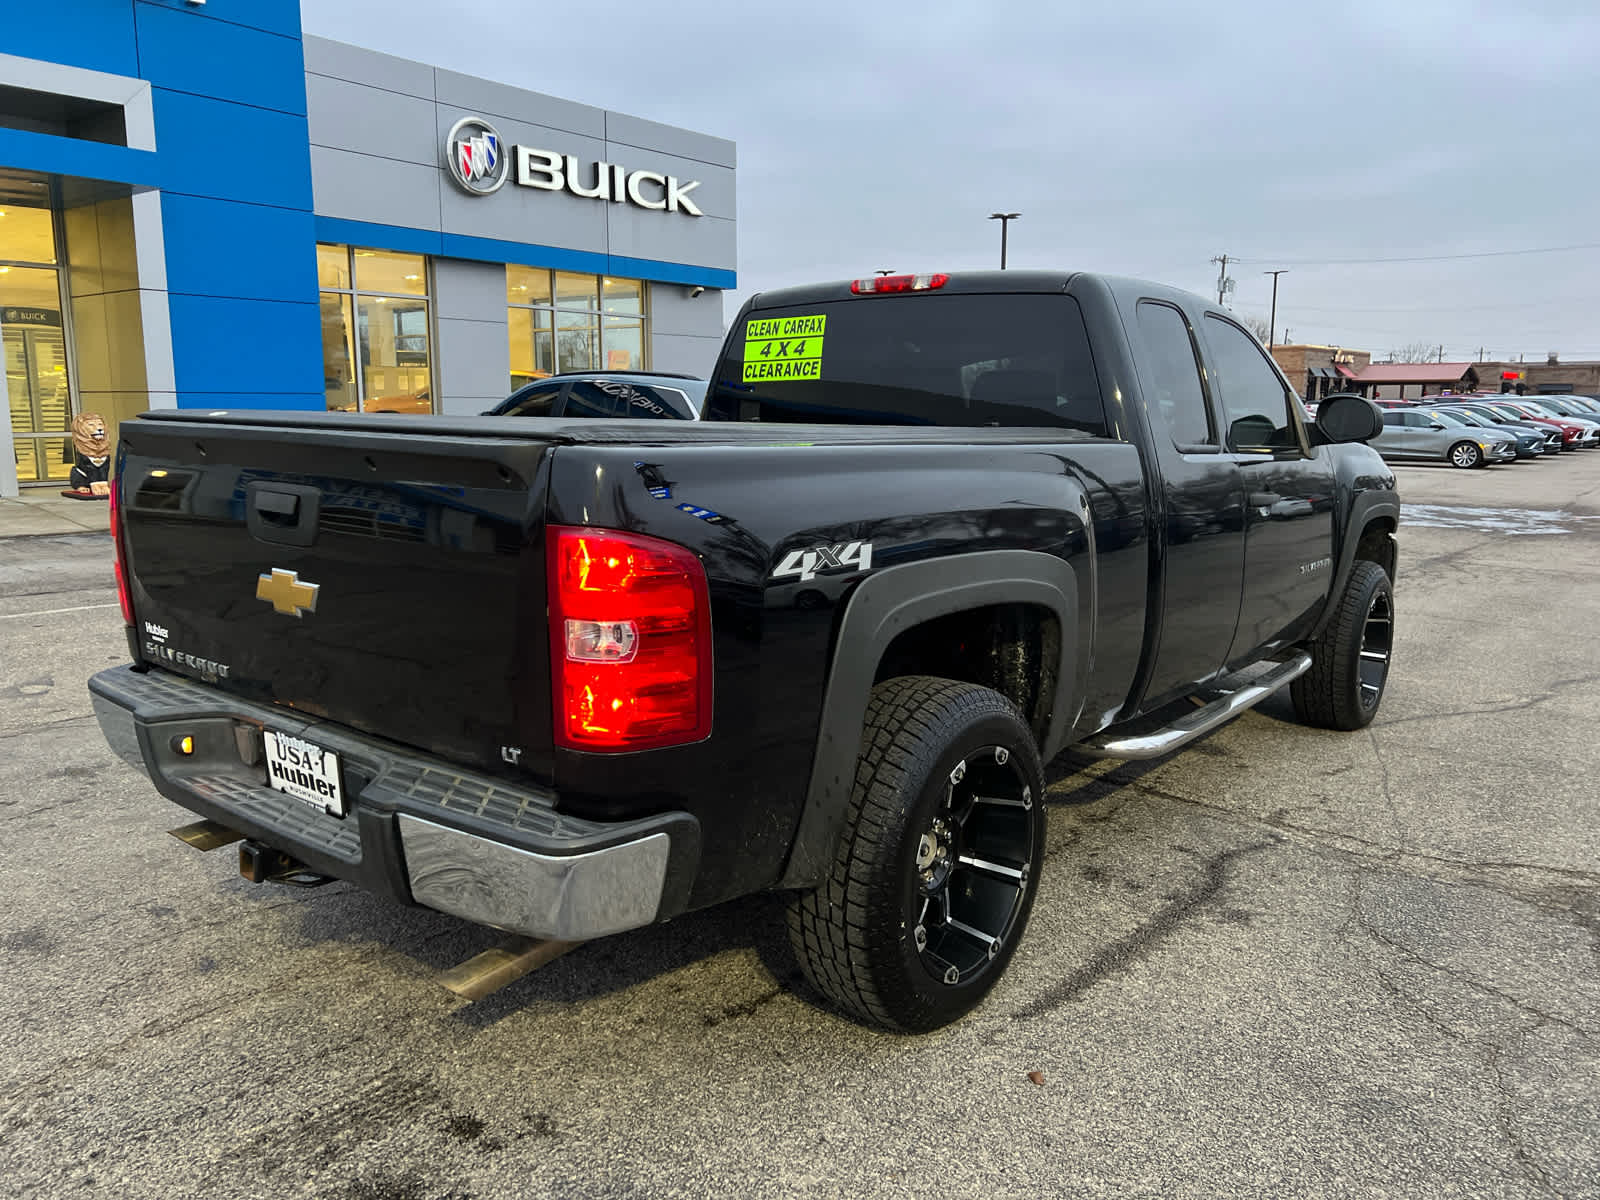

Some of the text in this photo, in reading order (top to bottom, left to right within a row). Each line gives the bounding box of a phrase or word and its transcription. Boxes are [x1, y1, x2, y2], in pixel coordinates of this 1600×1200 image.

[513, 144, 704, 217] BUICK
[20, 312, 47, 320] BUICK
[748, 318, 824, 337] CLEAN CARFAX
[744, 361, 820, 379] CLEARANCE
[501, 746, 521, 765] LT
[271, 760, 336, 799] Hubler
